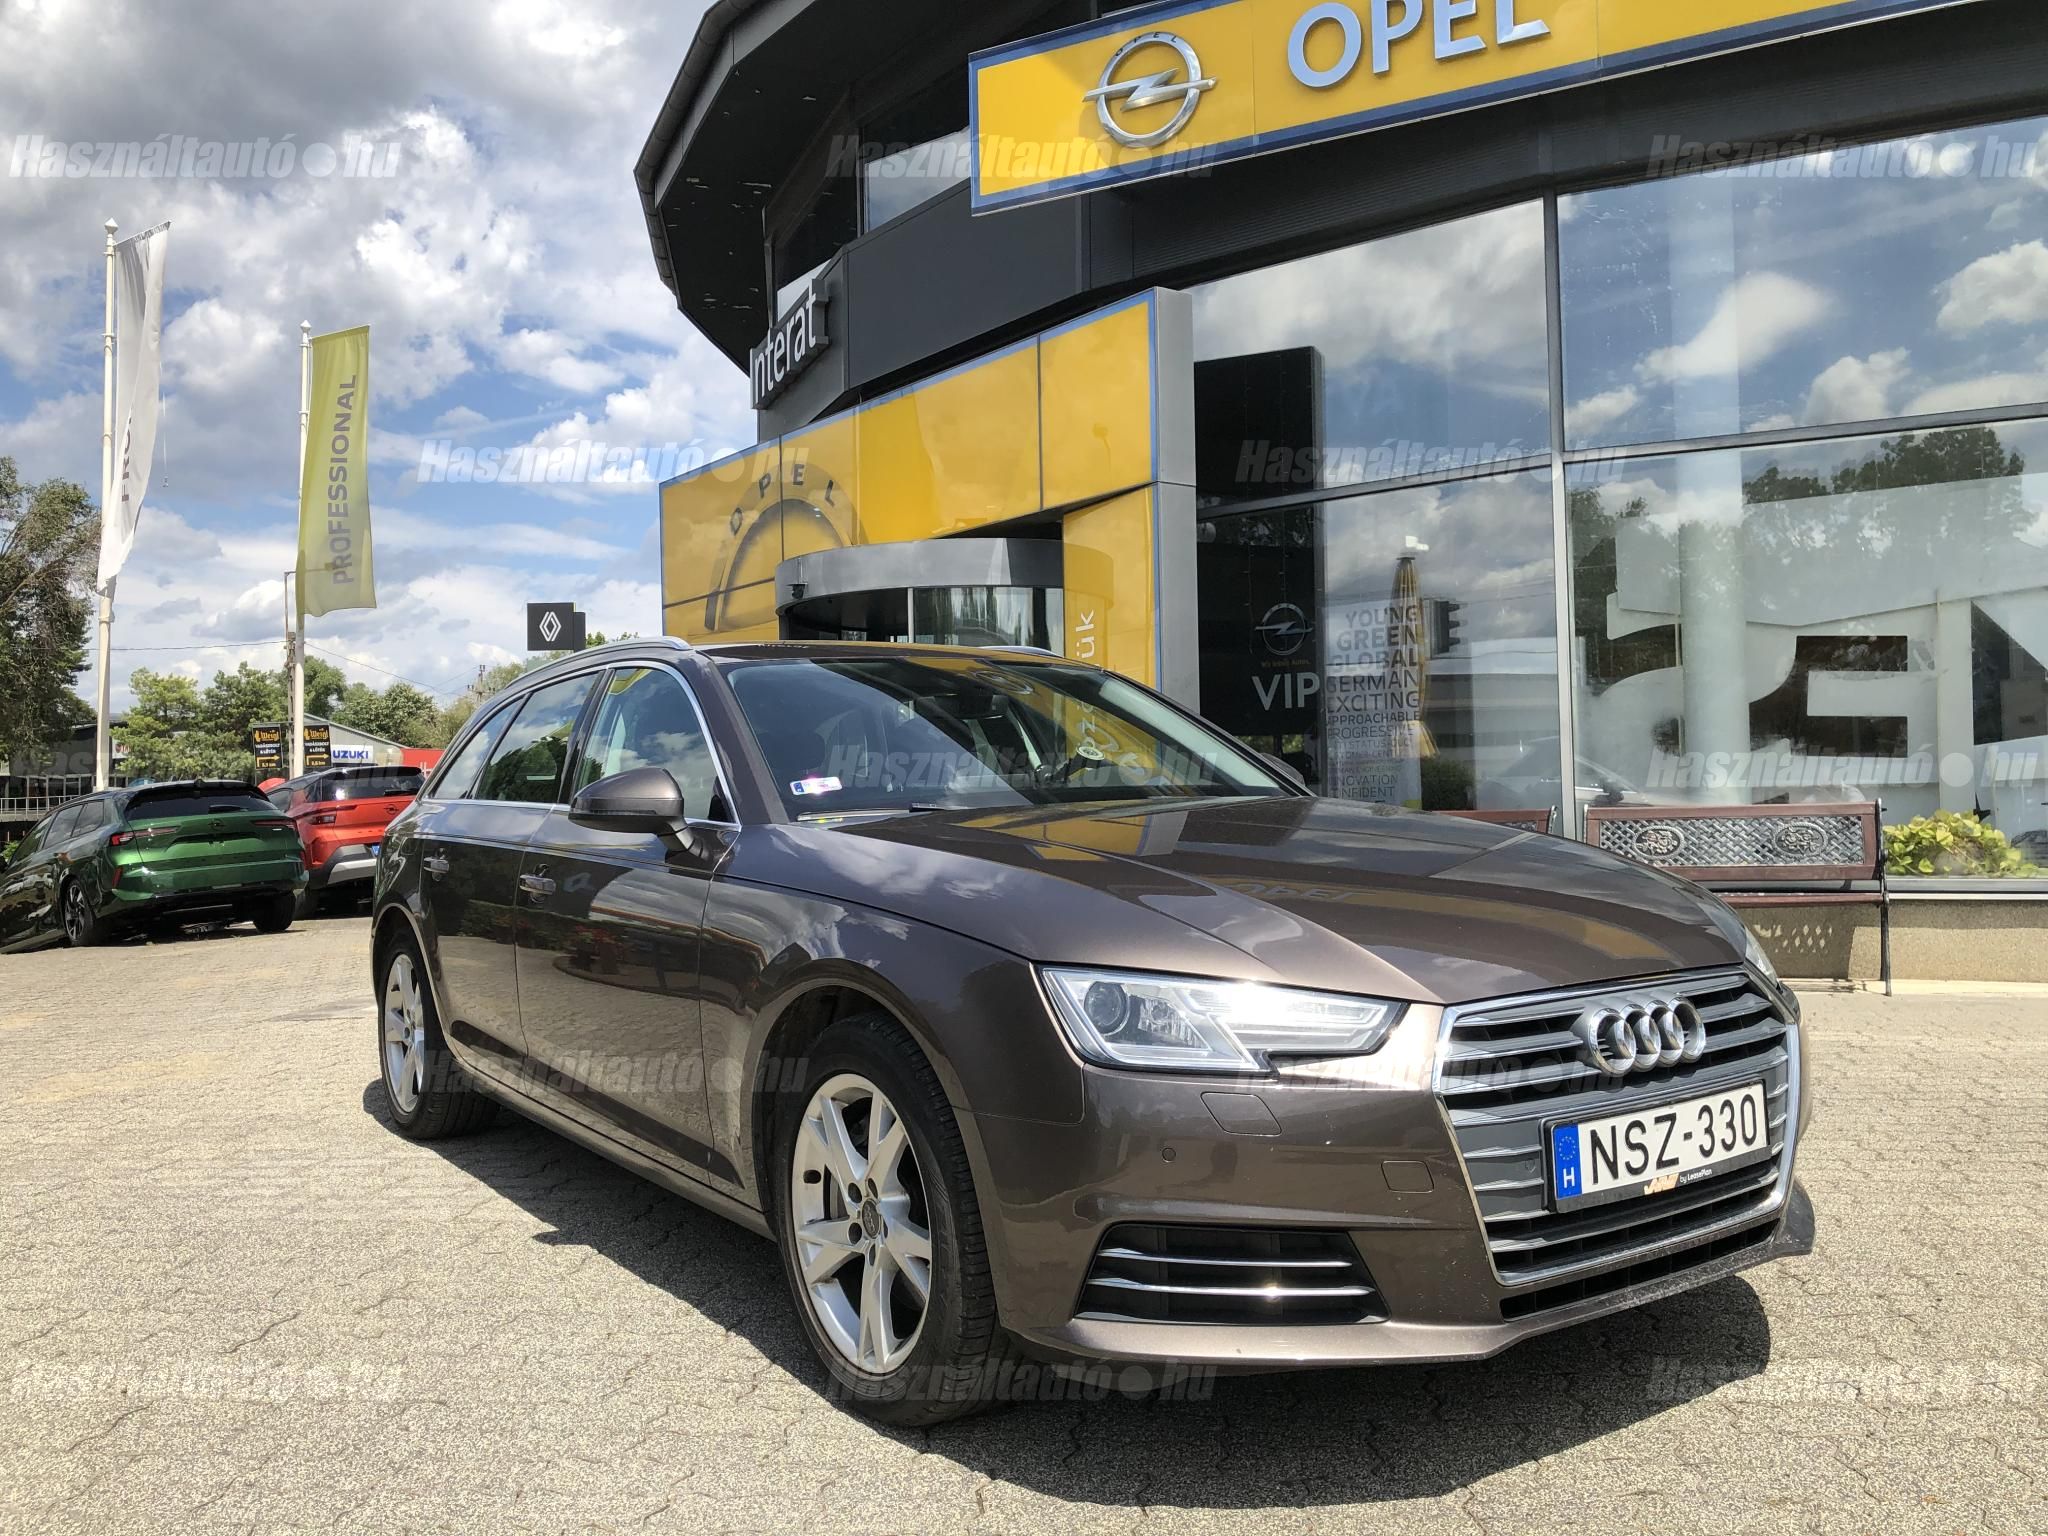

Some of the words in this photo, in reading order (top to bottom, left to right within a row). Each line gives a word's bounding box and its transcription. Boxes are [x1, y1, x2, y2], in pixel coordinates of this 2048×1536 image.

[1288, 0, 1551, 88] OPEL
[749, 282, 816, 409] Interat
[327, 375, 357, 585] PROFESSIONAL
[729, 463, 835, 536] OPEL
[1345, 605, 1418, 629] YOUNG
[1336, 624, 1418, 652] GREEN
[1330, 647, 1418, 674] GLOBAL
[1251, 671, 1320, 711] VIP
[1326, 669, 1419, 694] GERMAN
[1327, 690, 1420, 713] EXCITING
[333, 750, 369, 760] UZUKI
[1589, 1093, 1758, 1185] NSZ-330
[1562, 1167, 1576, 1188] H
[1679, 1175, 1687, 1184] by
[1687, 1168, 1713, 1181] LeasePlan
